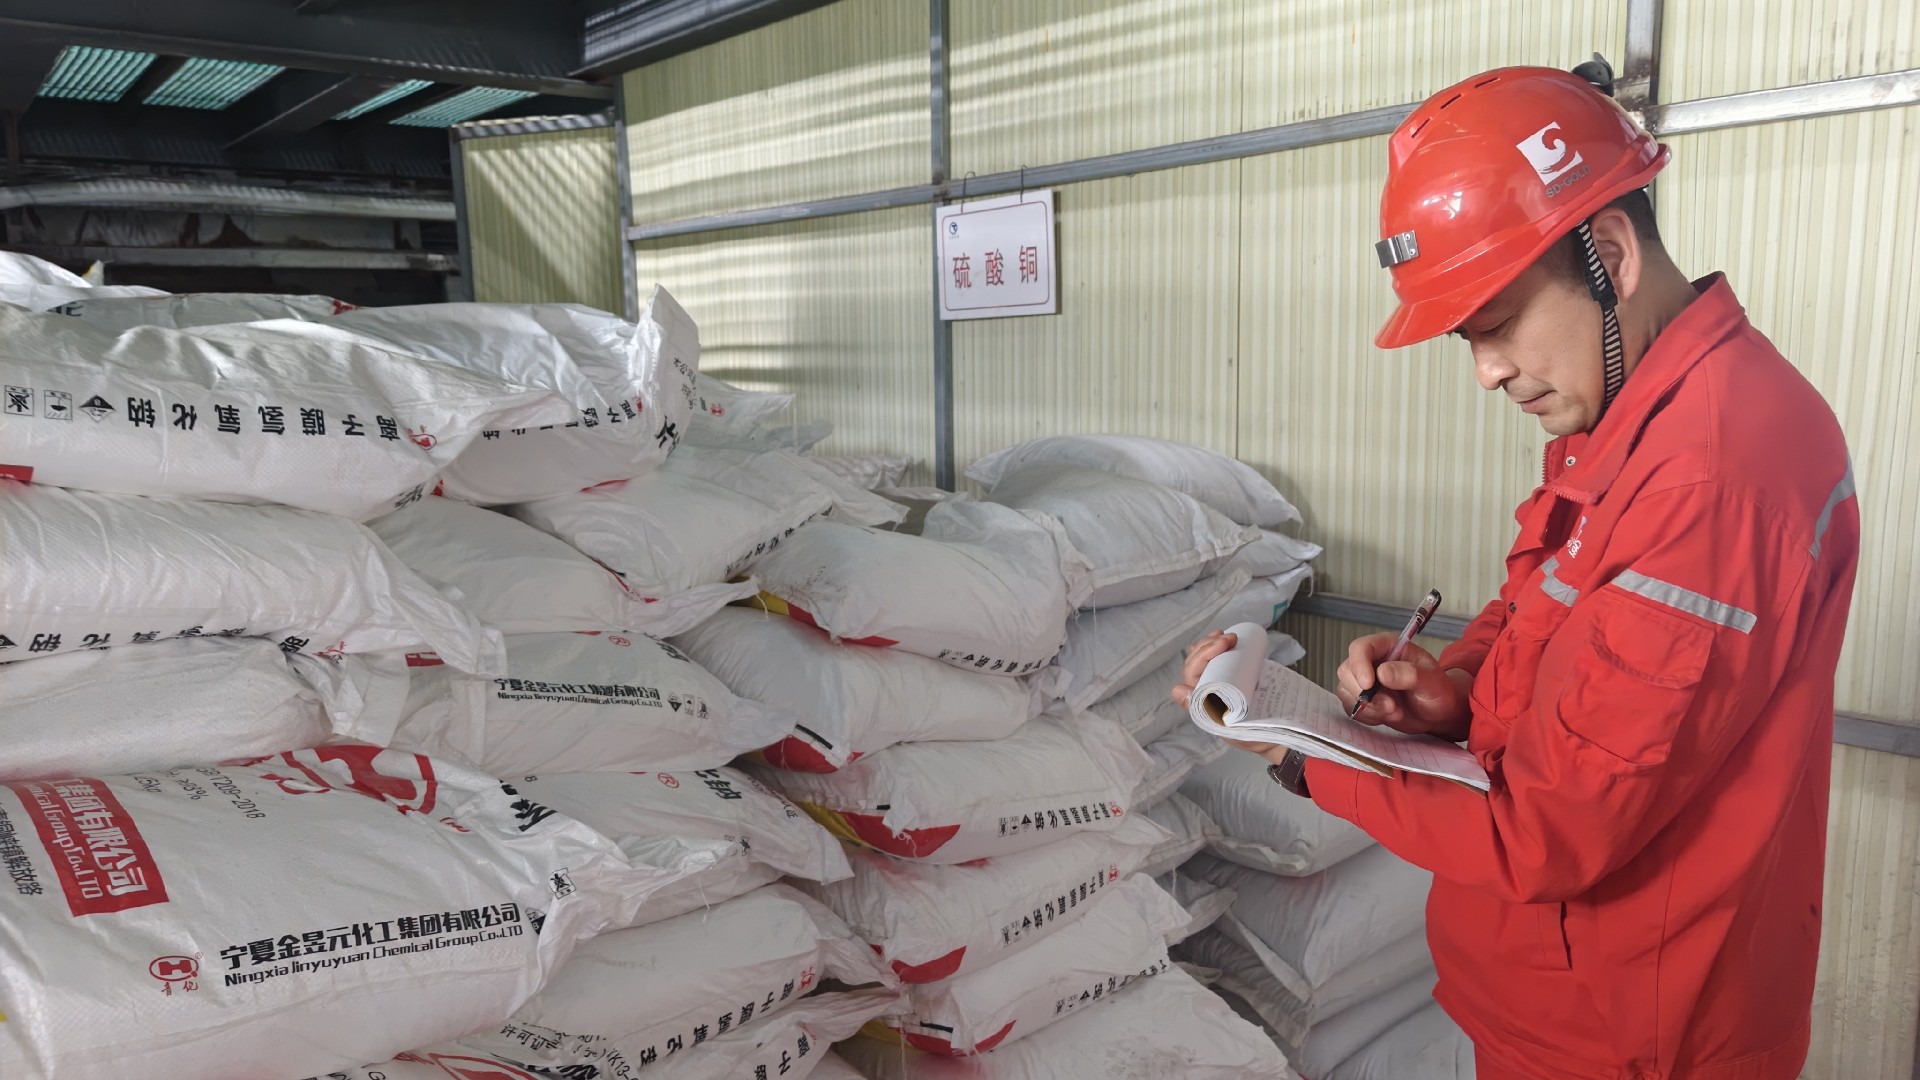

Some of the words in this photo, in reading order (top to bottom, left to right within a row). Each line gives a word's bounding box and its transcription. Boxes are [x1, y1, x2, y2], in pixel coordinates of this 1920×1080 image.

[1545, 164, 1591, 198] SD-GOLD
[952, 244, 1038, 289] 硫酸铜
[128, 396, 400, 441] 离子膜氢氧化钠
[44, 808, 75, 848] Group
[219, 902, 521, 970] 宁夏金昱元化工集团有限公司
[224, 965, 289, 987] Ningxia
[291, 950, 370, 974] Jinyuyuan
[372, 937, 434, 959] Chemical
[435, 934, 479, 949] Group
